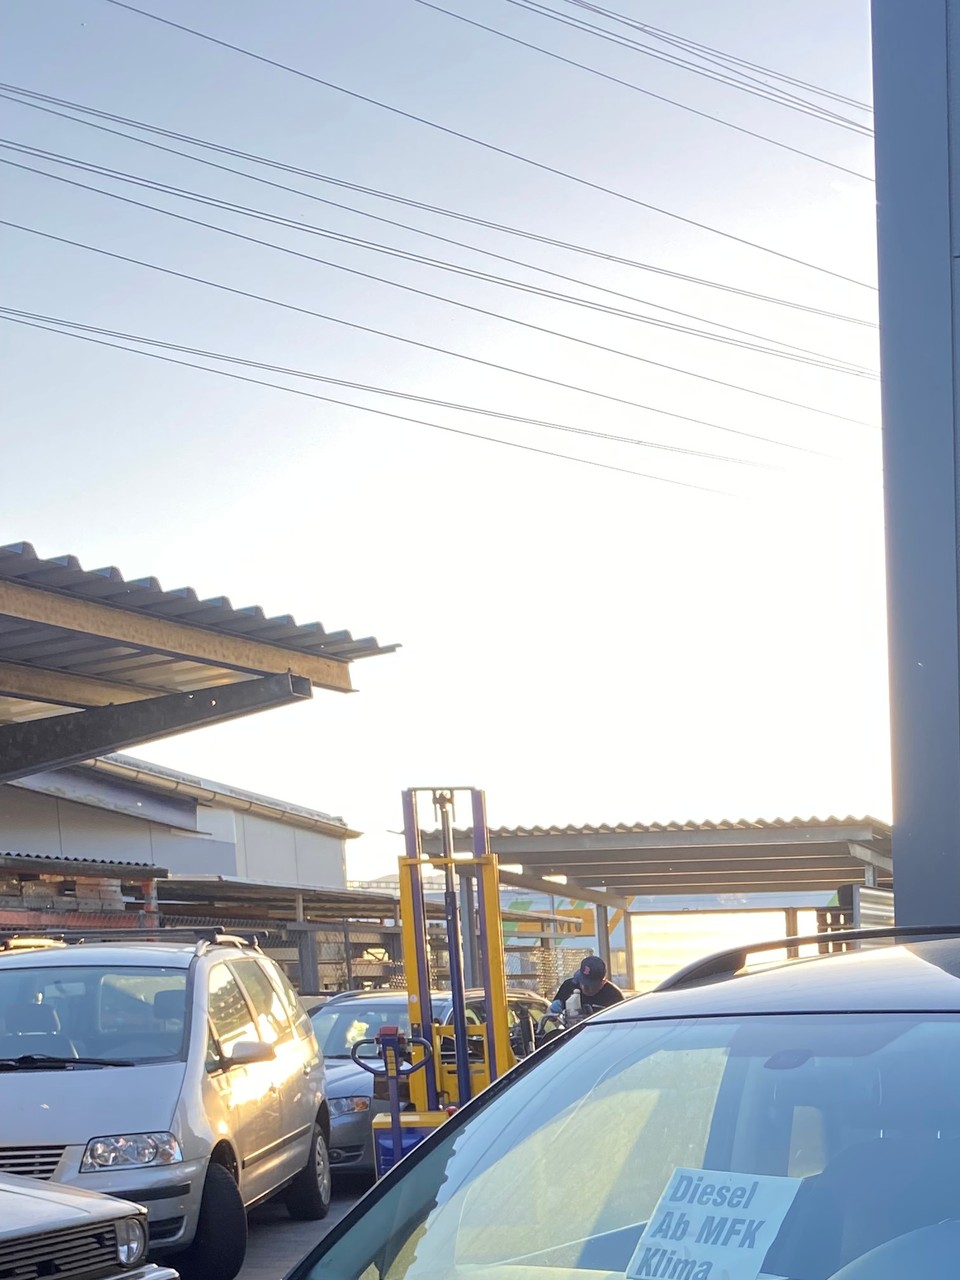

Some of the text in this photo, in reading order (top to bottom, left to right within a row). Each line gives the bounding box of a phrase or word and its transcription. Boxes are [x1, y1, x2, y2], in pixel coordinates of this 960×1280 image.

[669, 1175, 759, 1209] Diesel
[650, 1211, 766, 1249] Ab MFK
